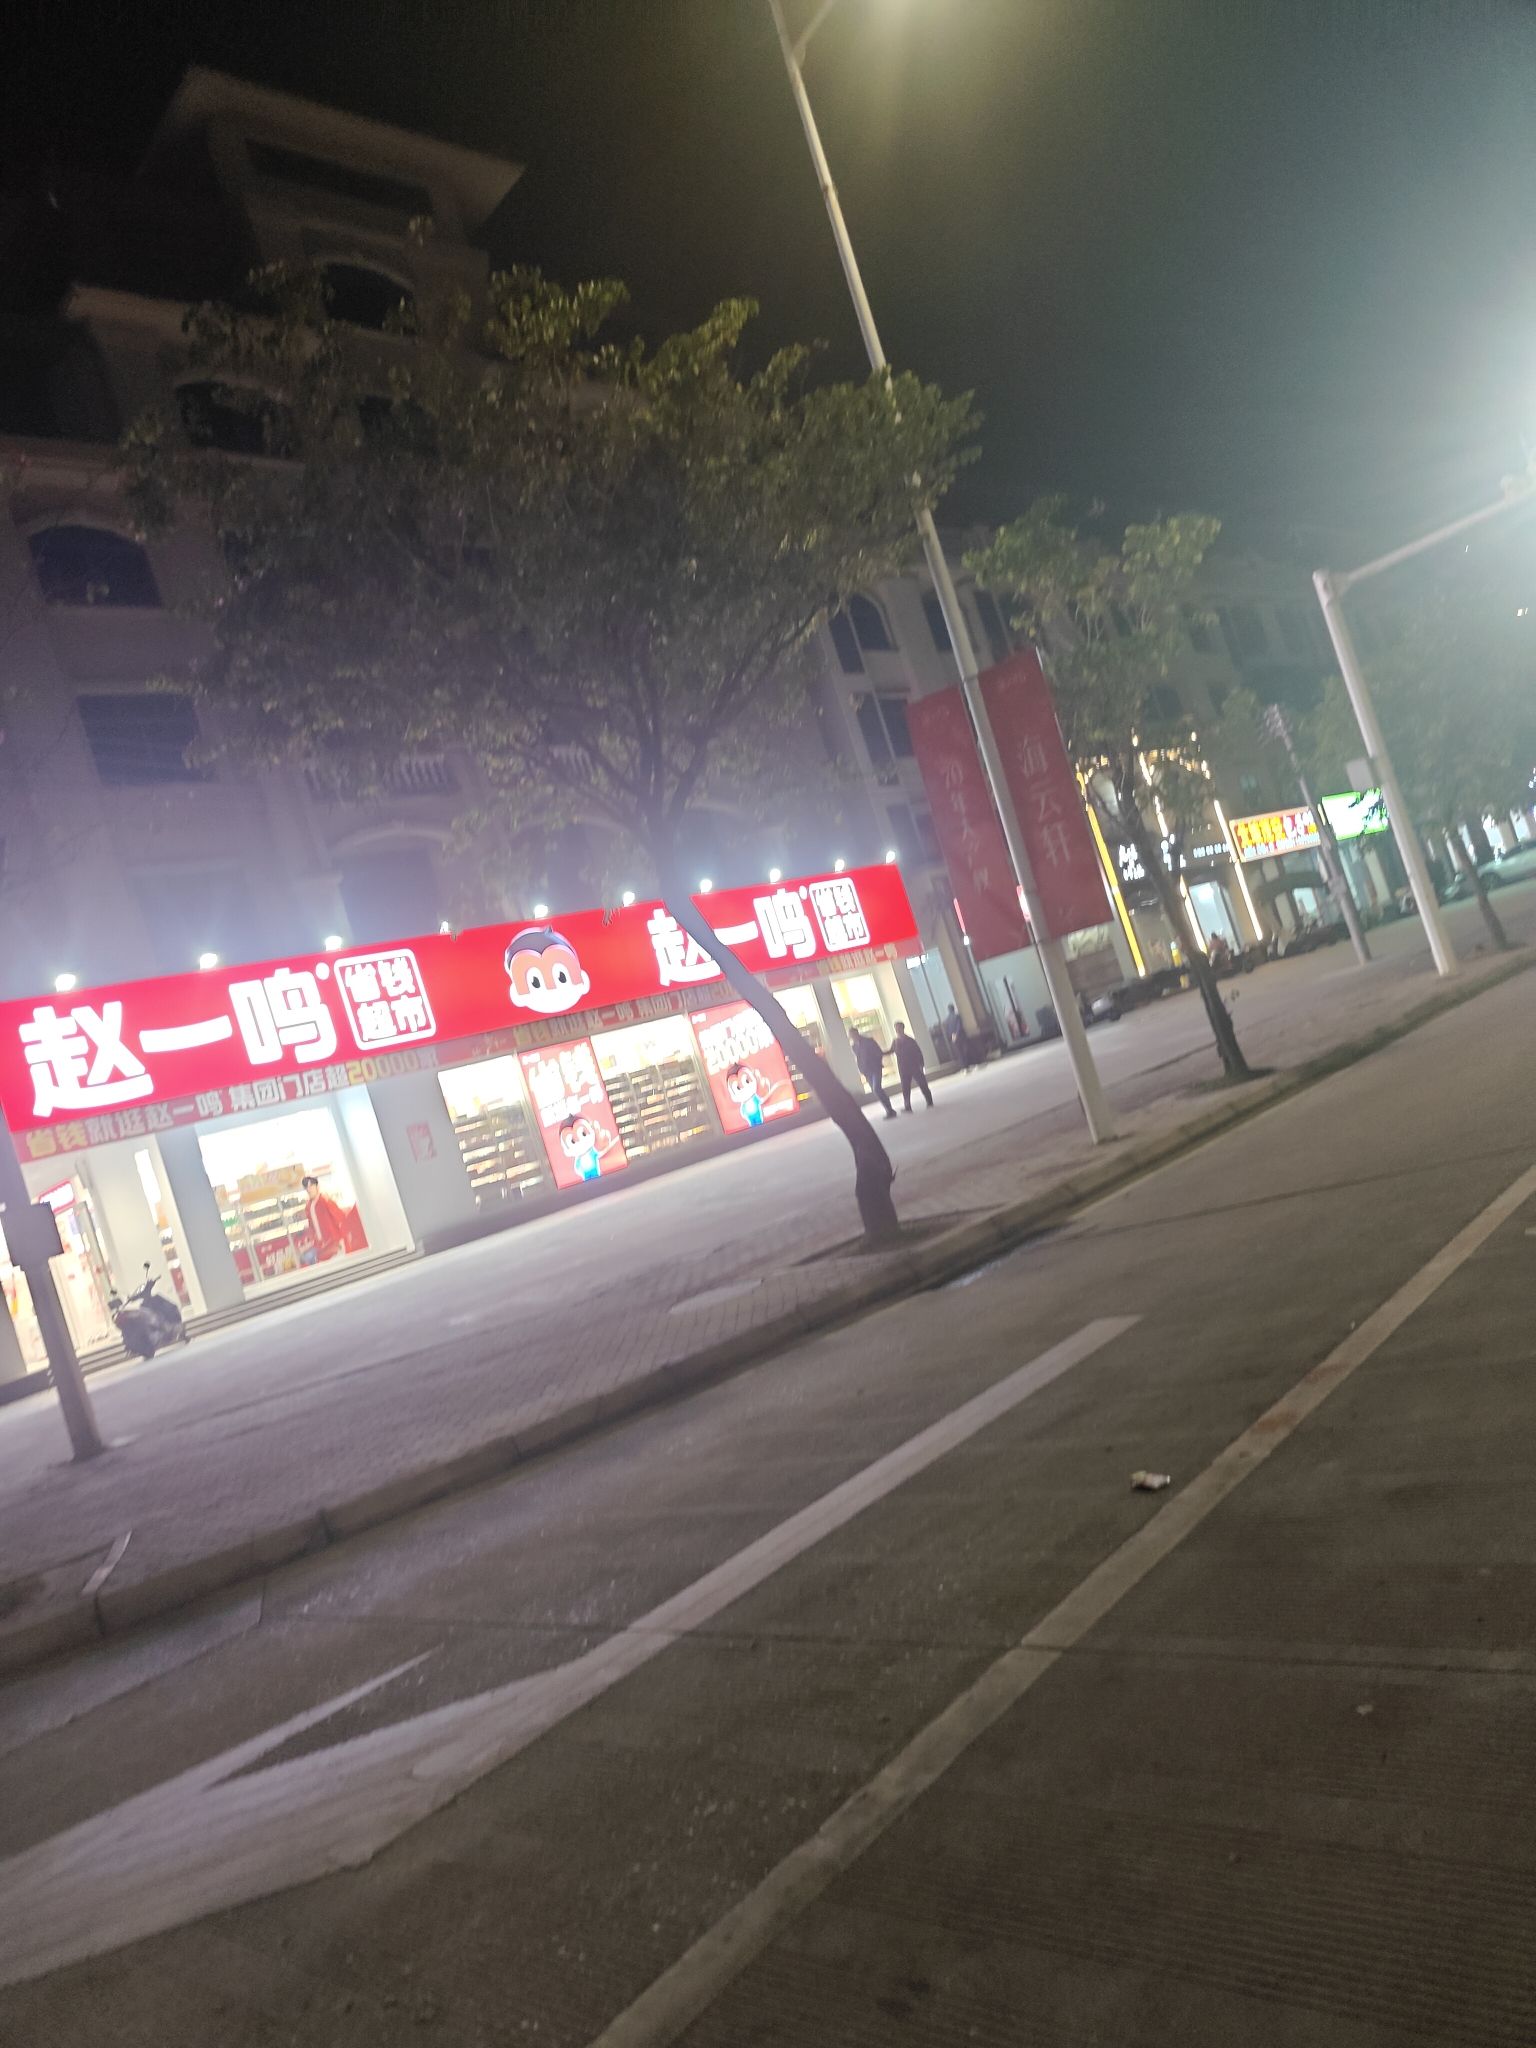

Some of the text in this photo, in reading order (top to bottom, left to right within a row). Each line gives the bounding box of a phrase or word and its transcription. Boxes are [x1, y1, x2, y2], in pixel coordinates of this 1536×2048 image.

[344, 955, 416, 1003] 省钱
[647, 888, 816, 987] 赵一鸣
[18, 967, 337, 1118] 赵一鸣
